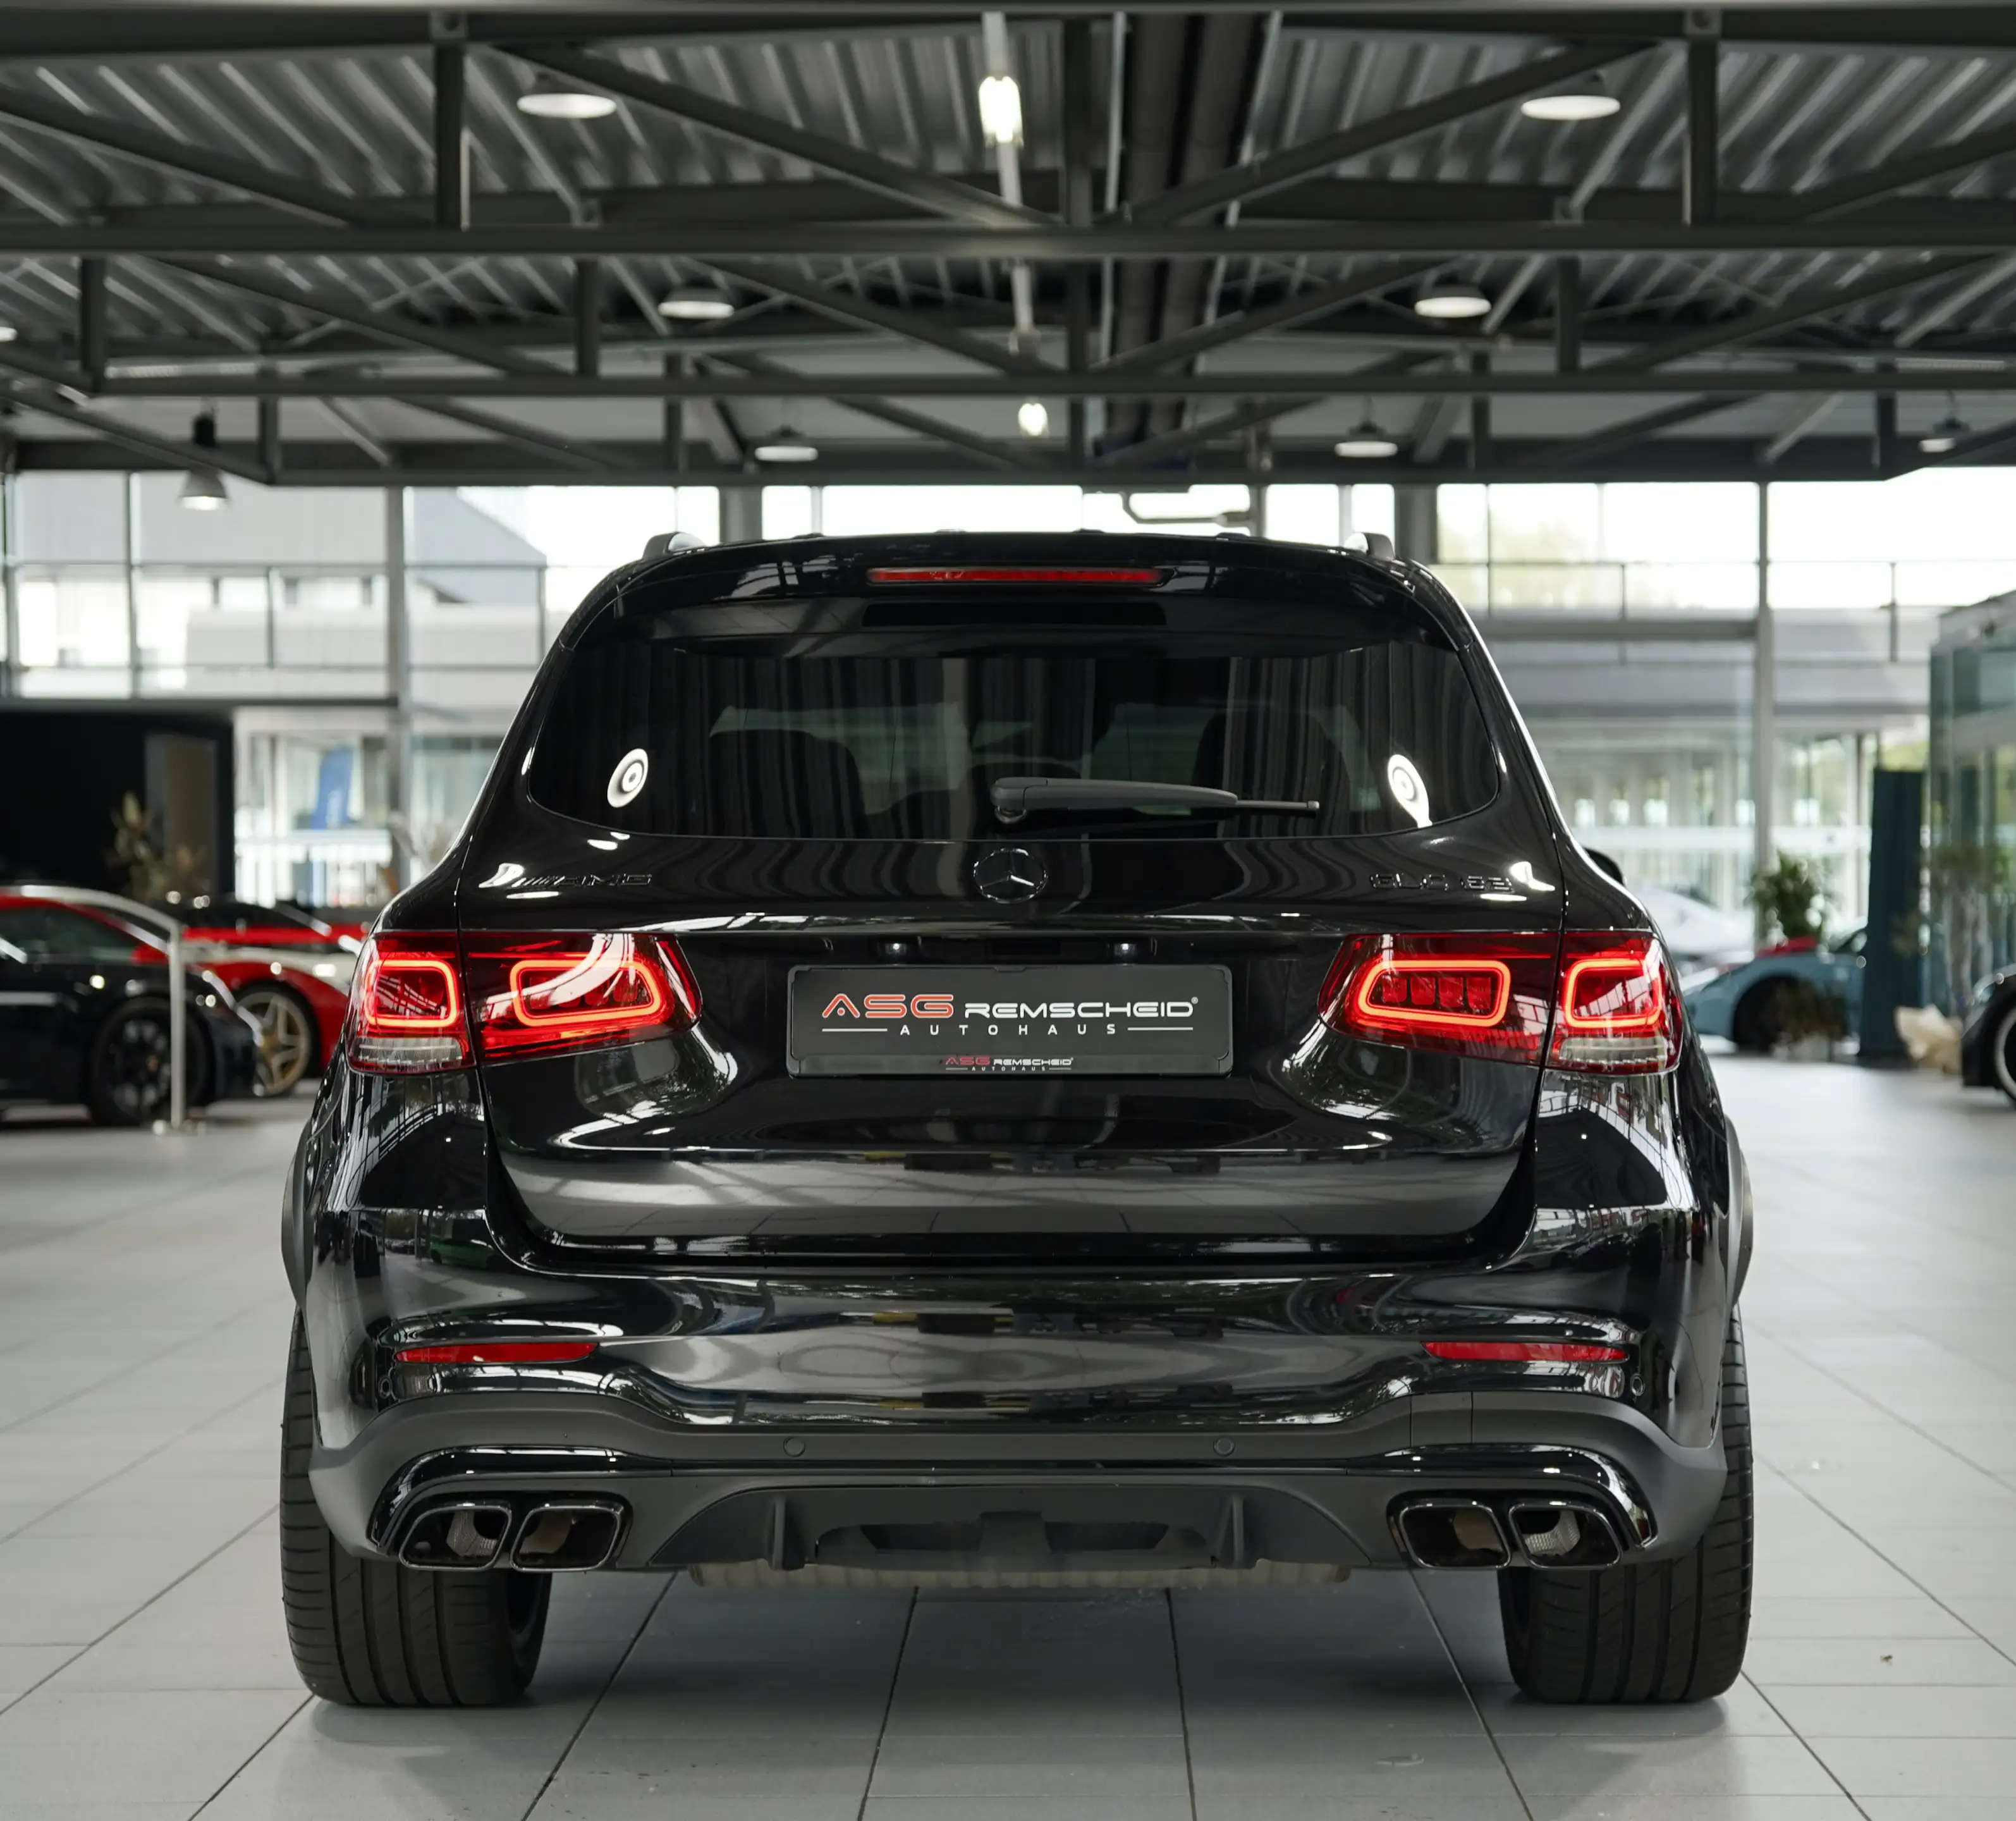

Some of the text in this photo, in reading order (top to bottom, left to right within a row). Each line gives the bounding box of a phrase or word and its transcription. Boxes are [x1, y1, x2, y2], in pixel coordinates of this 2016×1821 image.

[822, 993, 954, 1019] ASG
[900, 1024, 1116, 1036] AUTOHAUS
[945, 1056, 991, 1066] ASG
